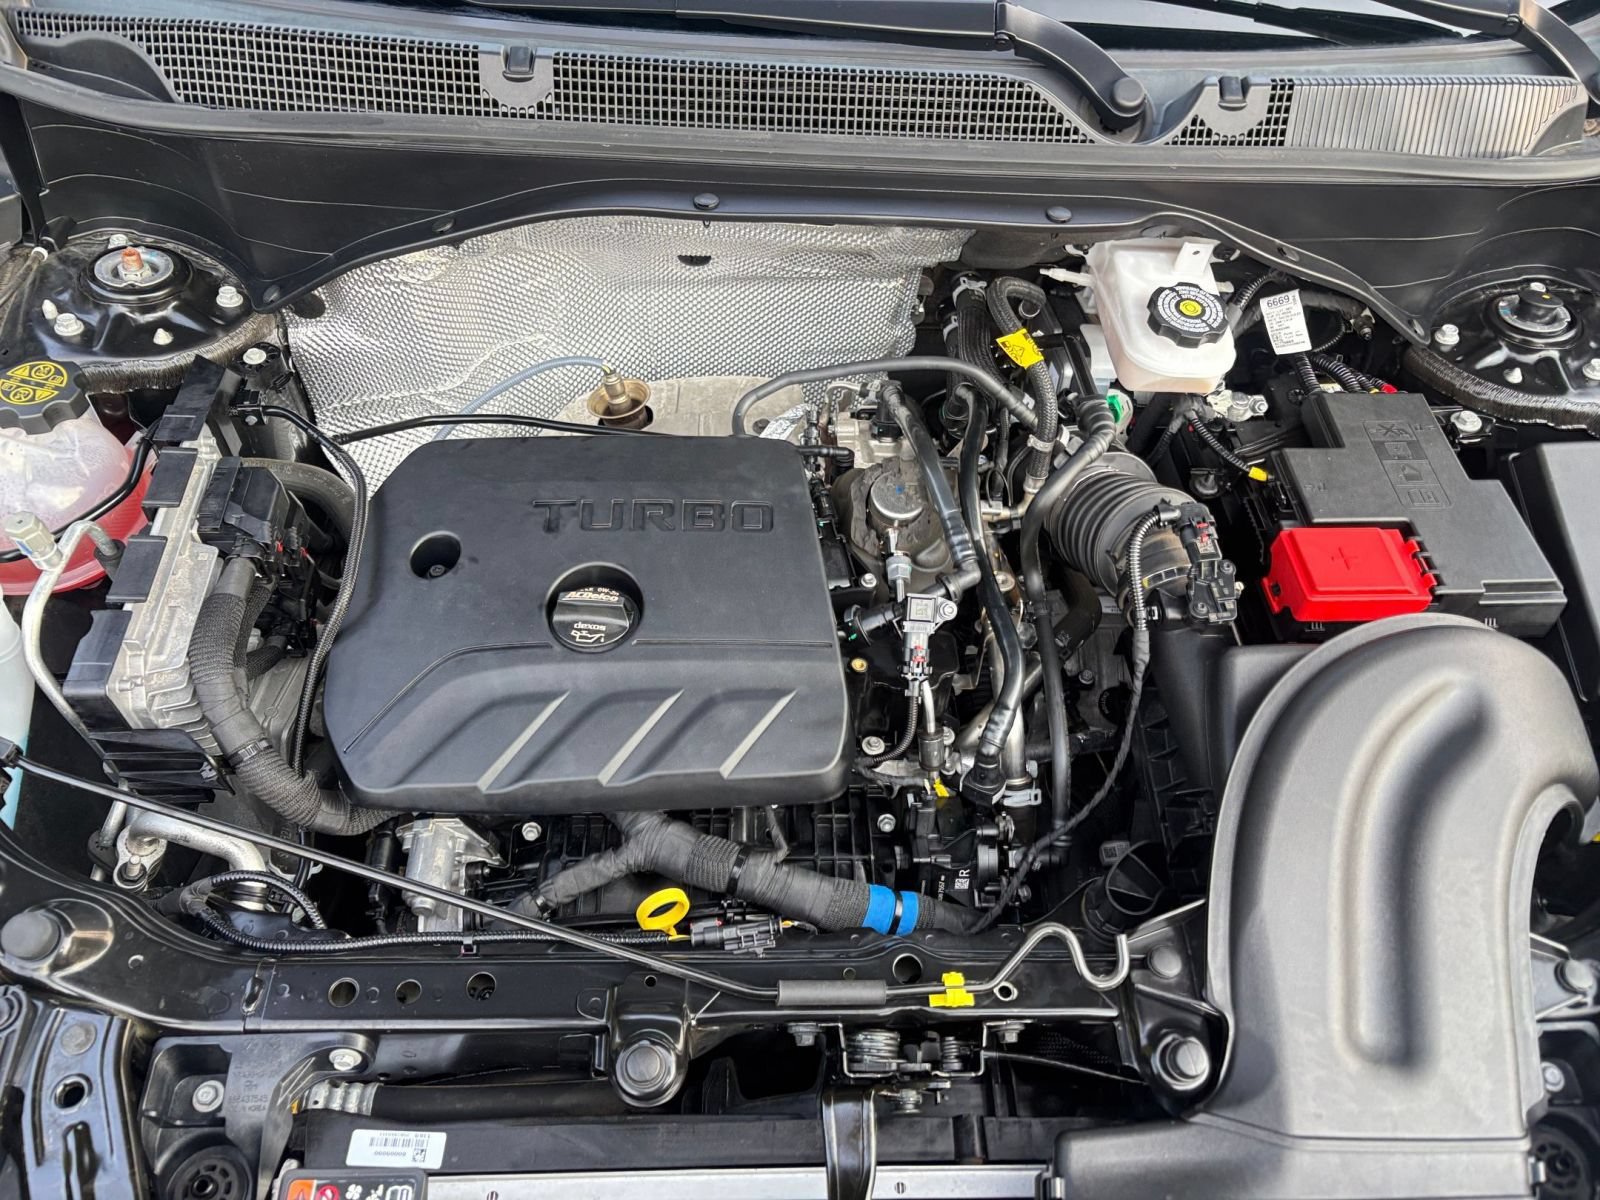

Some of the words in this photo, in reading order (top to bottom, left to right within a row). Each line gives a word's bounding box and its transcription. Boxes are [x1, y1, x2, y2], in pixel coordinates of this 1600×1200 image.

[1267, 295, 1290, 307] 6669
[533, 498, 774, 533] TURBO
[564, 591, 619, 602] ACDelco
[574, 622, 606, 630] dexos
